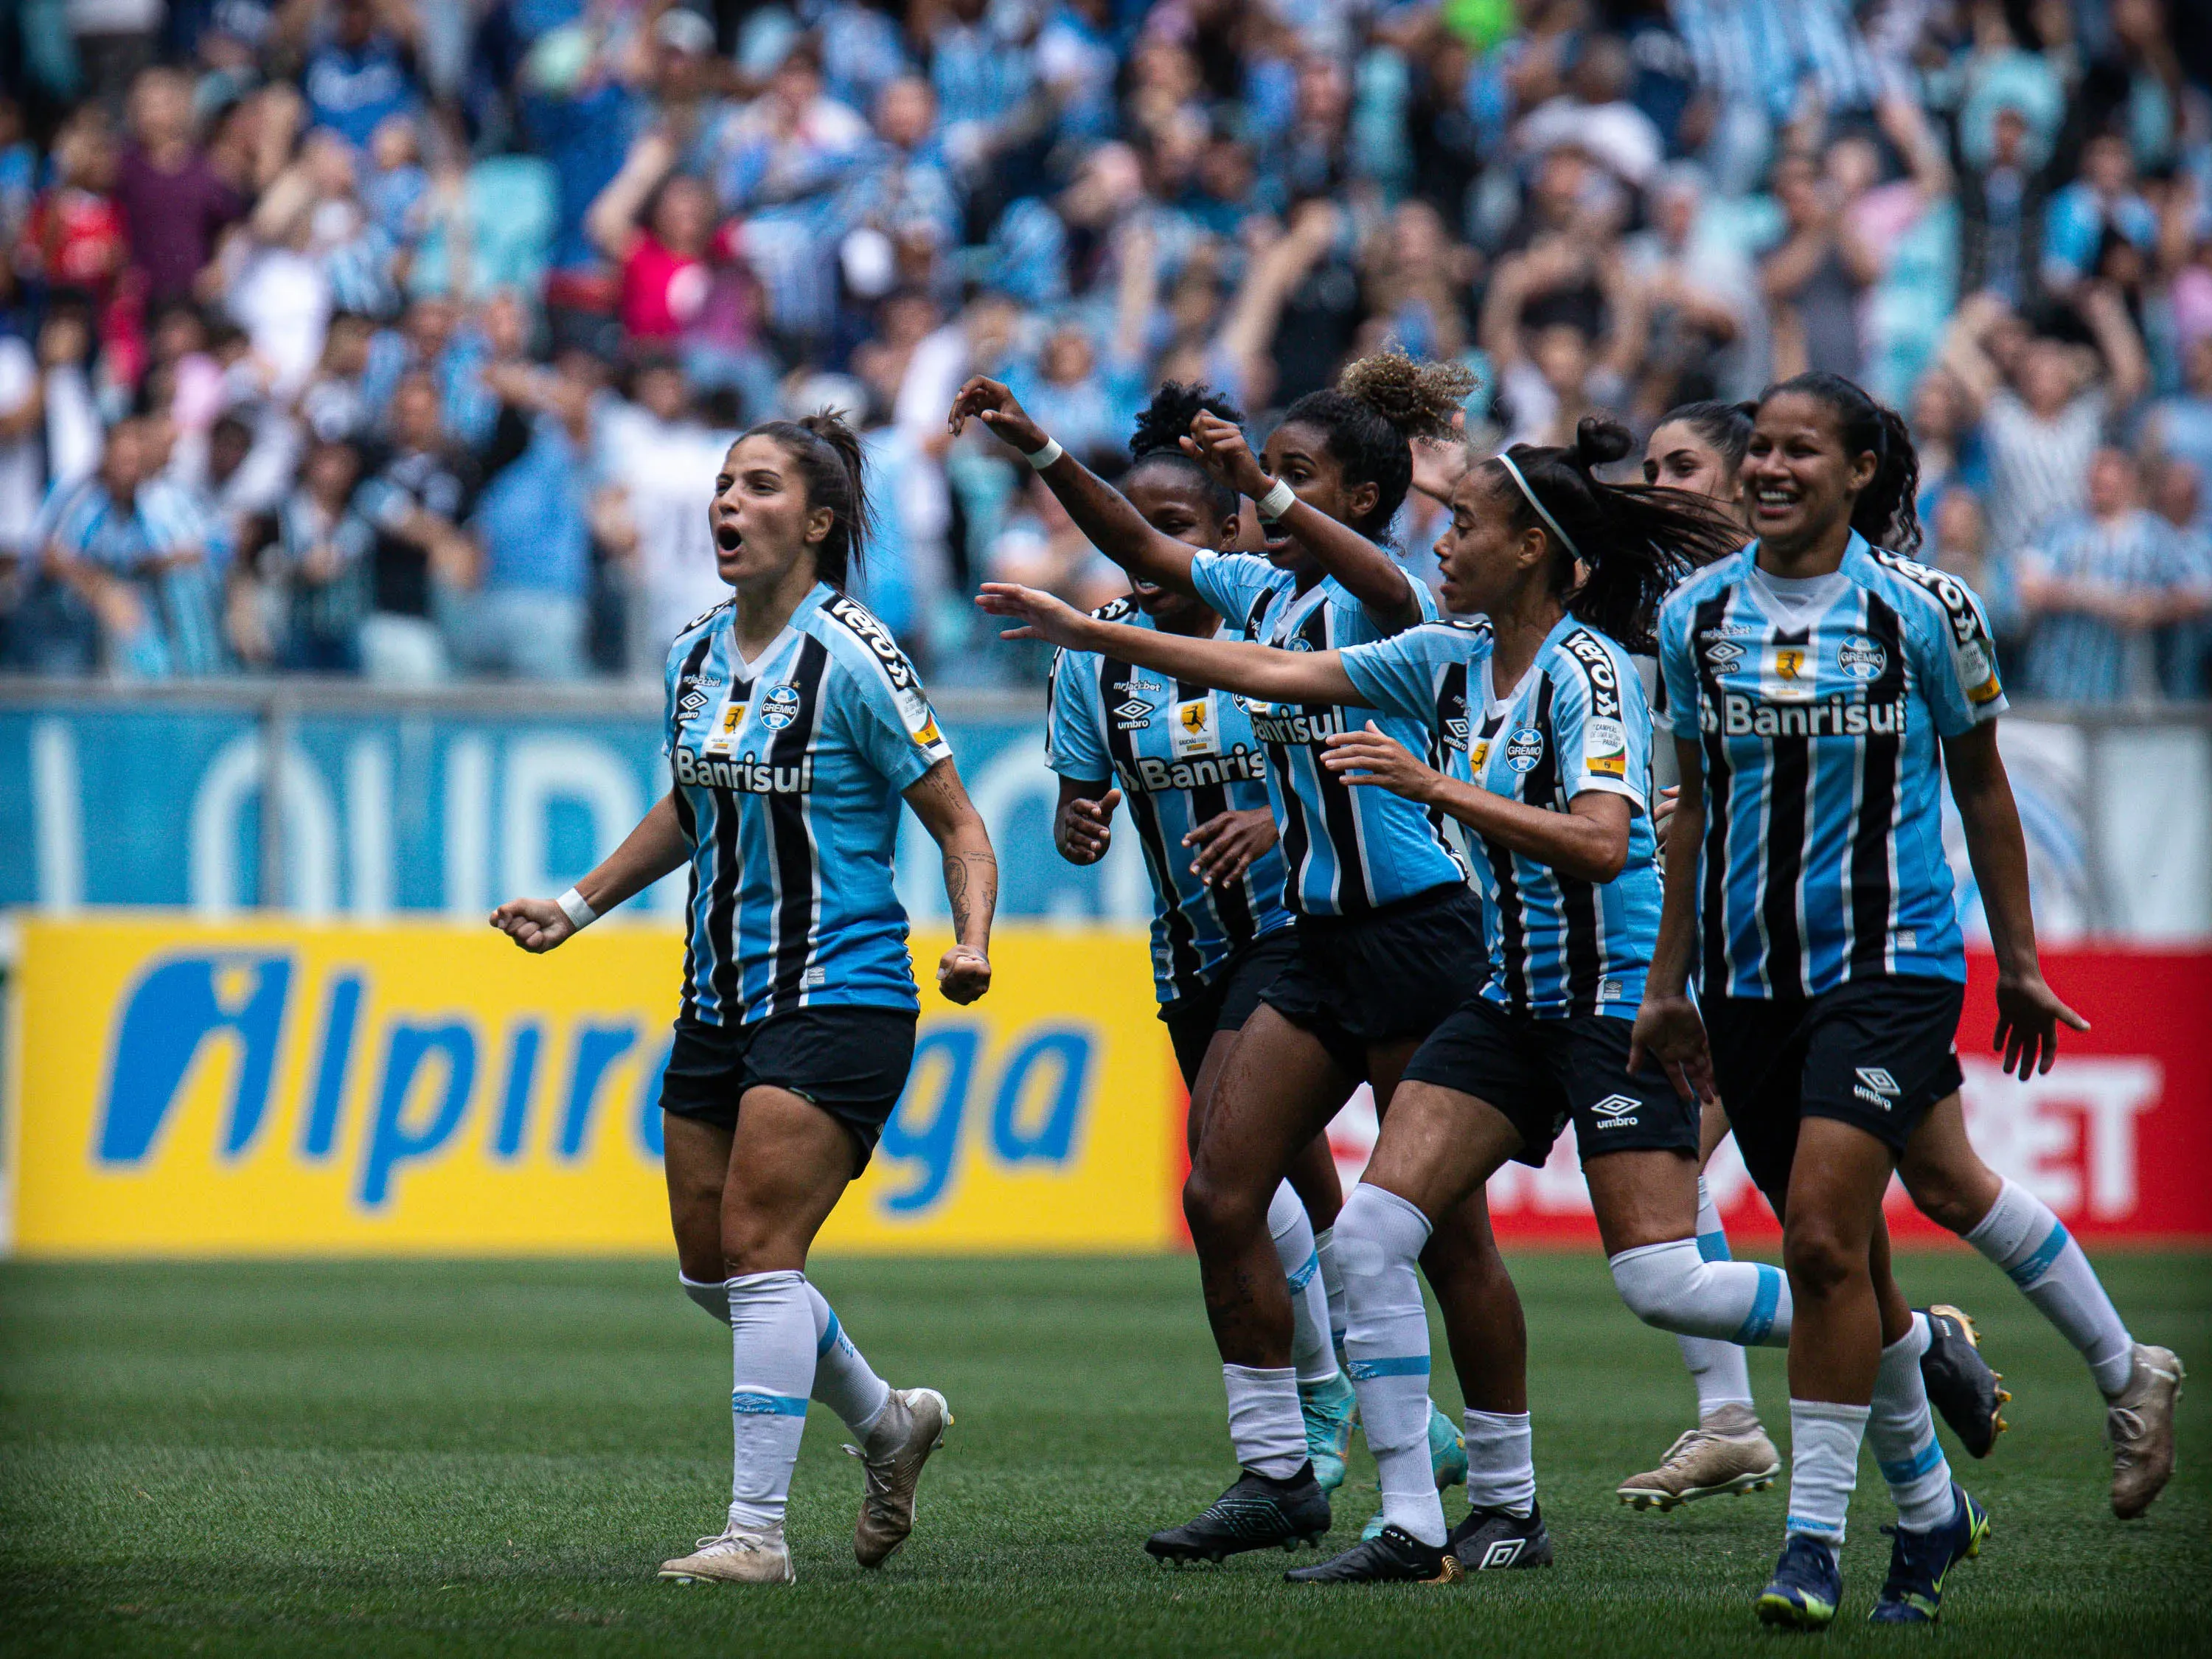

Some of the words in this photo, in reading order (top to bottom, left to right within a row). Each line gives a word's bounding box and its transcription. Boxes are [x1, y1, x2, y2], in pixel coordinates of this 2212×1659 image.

[762, 701, 796, 714] GRÊMIO
[1725, 692, 1907, 736] Banrisul
[678, 710, 698, 720] umbro
[1118, 718, 1149, 730] umbro
[1443, 734, 1467, 751] umbro
[1507, 744, 1541, 756] GRÊMIO
[676, 744, 811, 793] Banrisul
[1853, 1083, 1892, 1112] umbro
[1596, 1116, 1638, 1130] umbro
